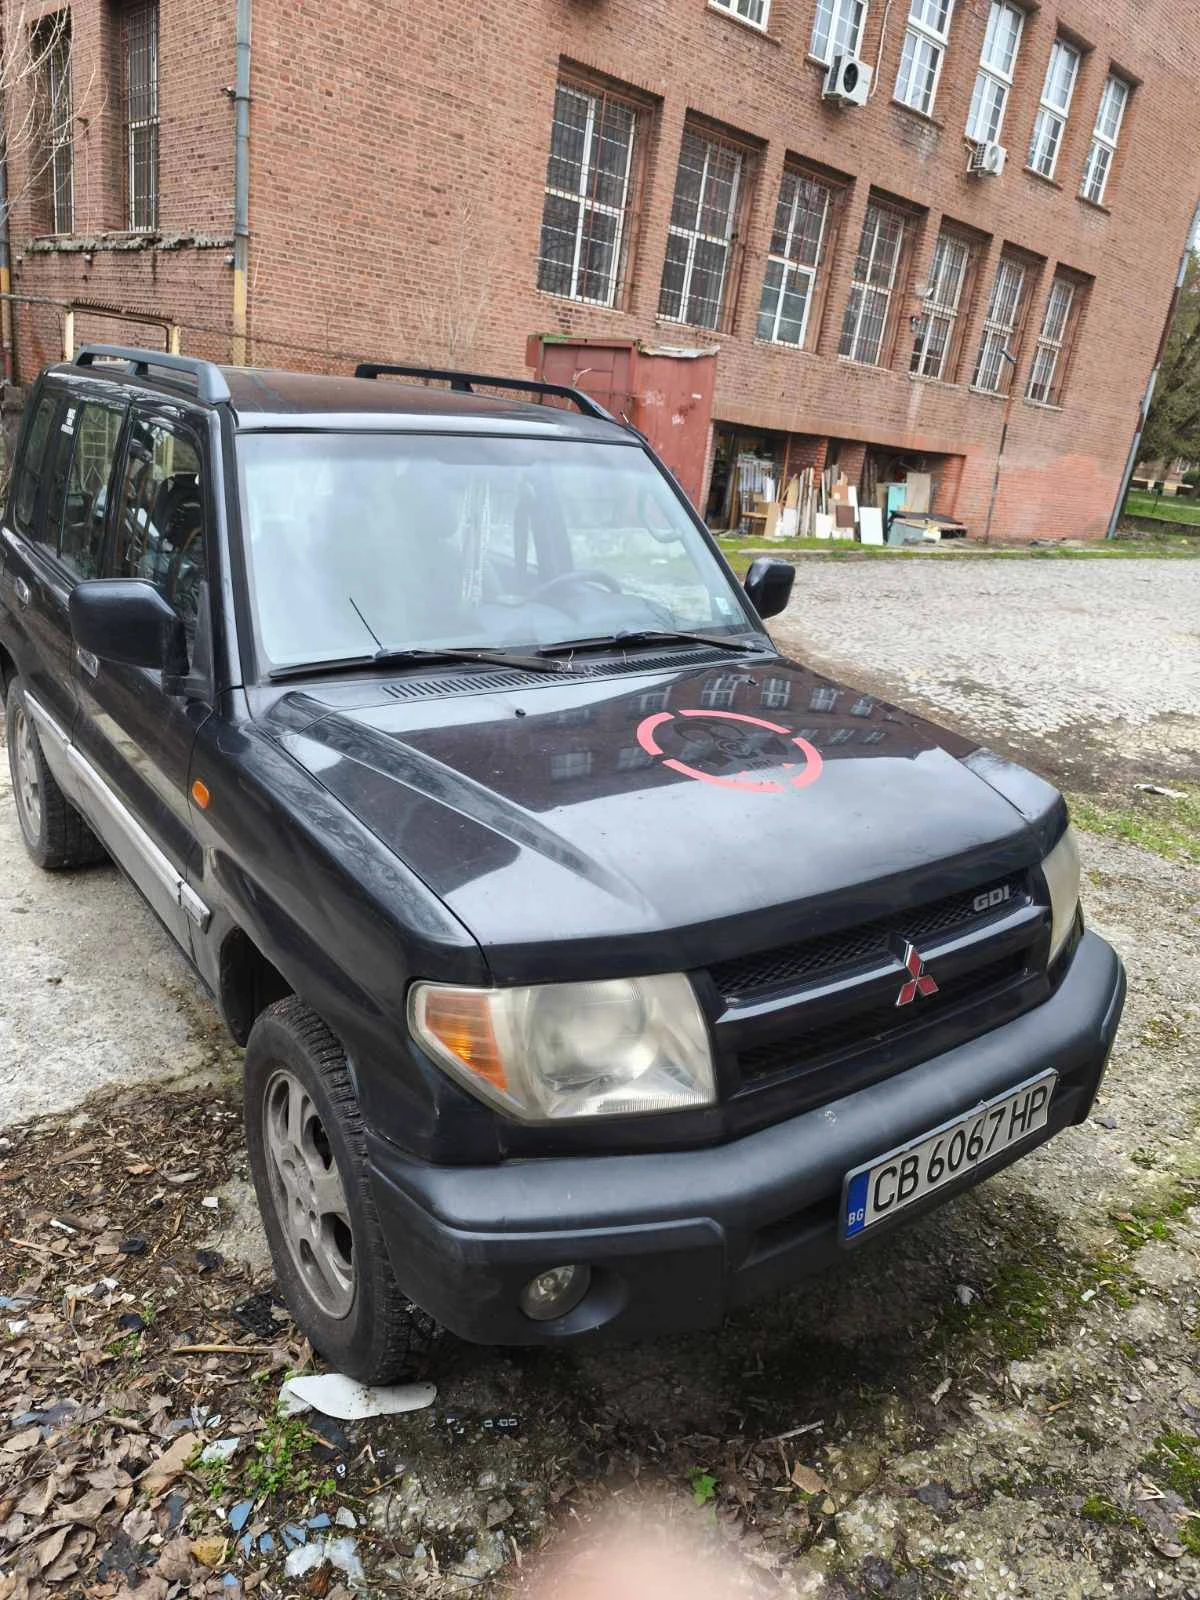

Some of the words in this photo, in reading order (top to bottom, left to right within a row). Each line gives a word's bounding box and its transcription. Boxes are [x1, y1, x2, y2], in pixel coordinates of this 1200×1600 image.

[973, 884, 1010, 912] GDI
[873, 1154, 919, 1213] CB
[926, 1107, 1007, 1184] 6067
[1007, 1085, 1048, 1141] HP
[848, 1208, 864, 1226] BG
